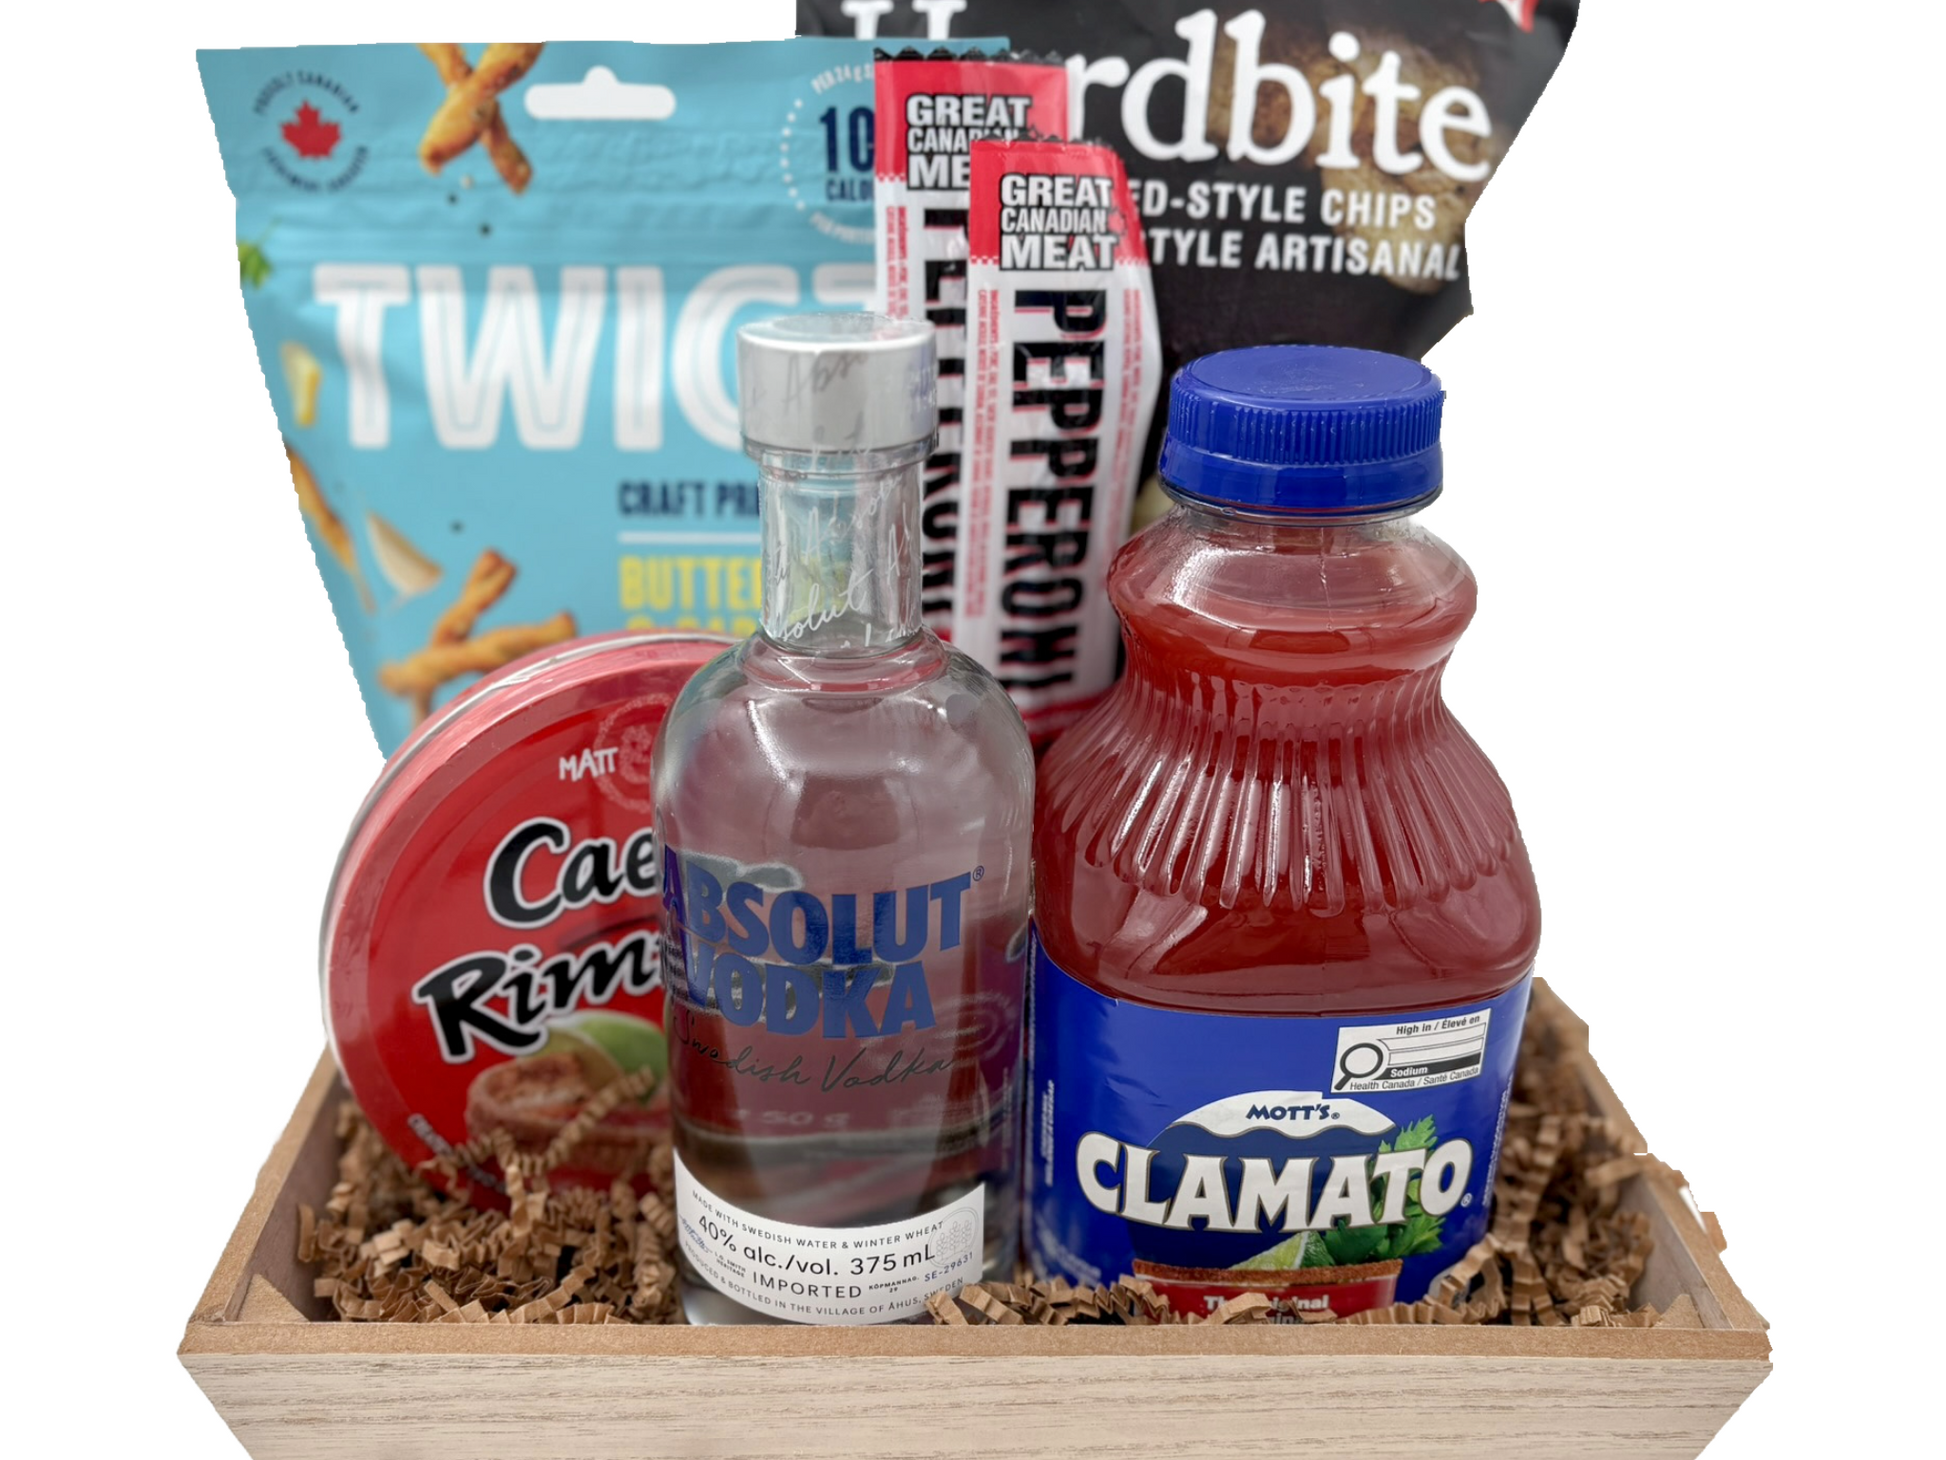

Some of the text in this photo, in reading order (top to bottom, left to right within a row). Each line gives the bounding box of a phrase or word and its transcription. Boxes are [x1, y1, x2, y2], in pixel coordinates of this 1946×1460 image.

[905, 92, 1032, 128] GREAT
[999, 174, 1114, 208] GREAT
[1319, 189, 1436, 230] CHIPS
[1000, 206, 1107, 234] CANADIAN
[999, 234, 1118, 271] MEAT
[1146, 228, 1461, 282] TYLE ARTISANAL
[619, 480, 706, 517] CRAFT
[997, 288, 1107, 691] PEPPERONI
[559, 747, 619, 782] MATT
[485, 815, 660, 929] Cae
[411, 927, 666, 1064] Rim
[678, 926, 936, 1039] VODKA
[1396, 1021, 1419, 1035] High
[1422, 1023, 1432, 1032] in
[1441, 1016, 1467, 1030] Élevé
[1469, 1014, 1481, 1023] en
[820, 1045, 953, 1093] Vodka
[1350, 1080, 1380, 1092] Health
[1382, 1078, 1416, 1090] Canada
[1424, 1073, 1449, 1085] Santé
[1449, 1066, 1480, 1081] Canada
[1390, 1066, 1429, 1079] Sodium
[692, 1189, 943, 1250] MADE WITH SWEDISH WATER & WINTER WHEAT
[699, 1215, 936, 1276] 40% alc./vol. 375 mL
[727, 1281, 771, 1306] BOTTLED
[774, 1300, 787, 1309] IN
[790, 1303, 812, 1314] THE
[815, 1307, 866, 1316] VILLAGE
[869, 1304, 884, 1314] OF
[753, 1271, 862, 1299] IMPORTED
